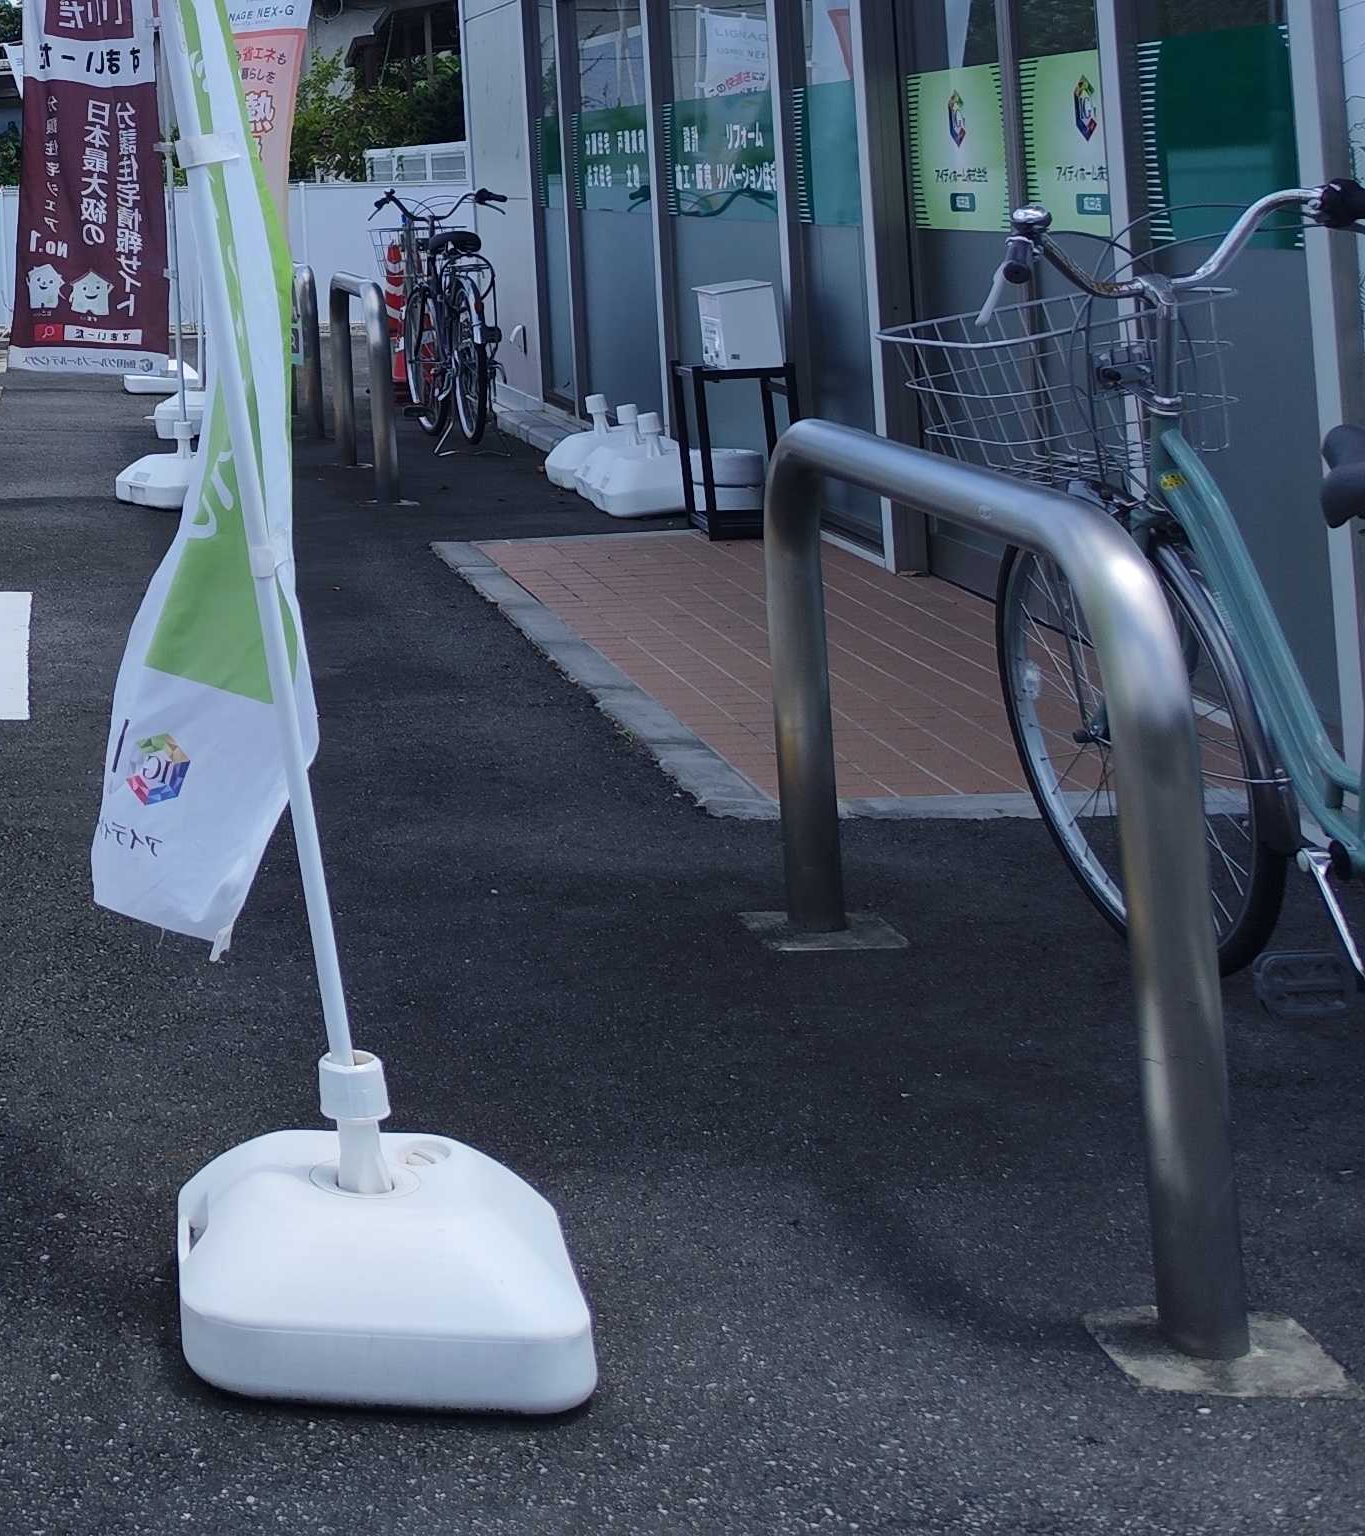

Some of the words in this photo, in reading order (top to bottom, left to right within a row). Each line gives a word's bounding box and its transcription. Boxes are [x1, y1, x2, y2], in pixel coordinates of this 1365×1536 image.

[229, 10, 253, 22] NAGE
[257, 4, 295, 19] NEX-G
[715, 27, 768, 42] LIGNAG
[725, 121, 764, 150] リフォーム
